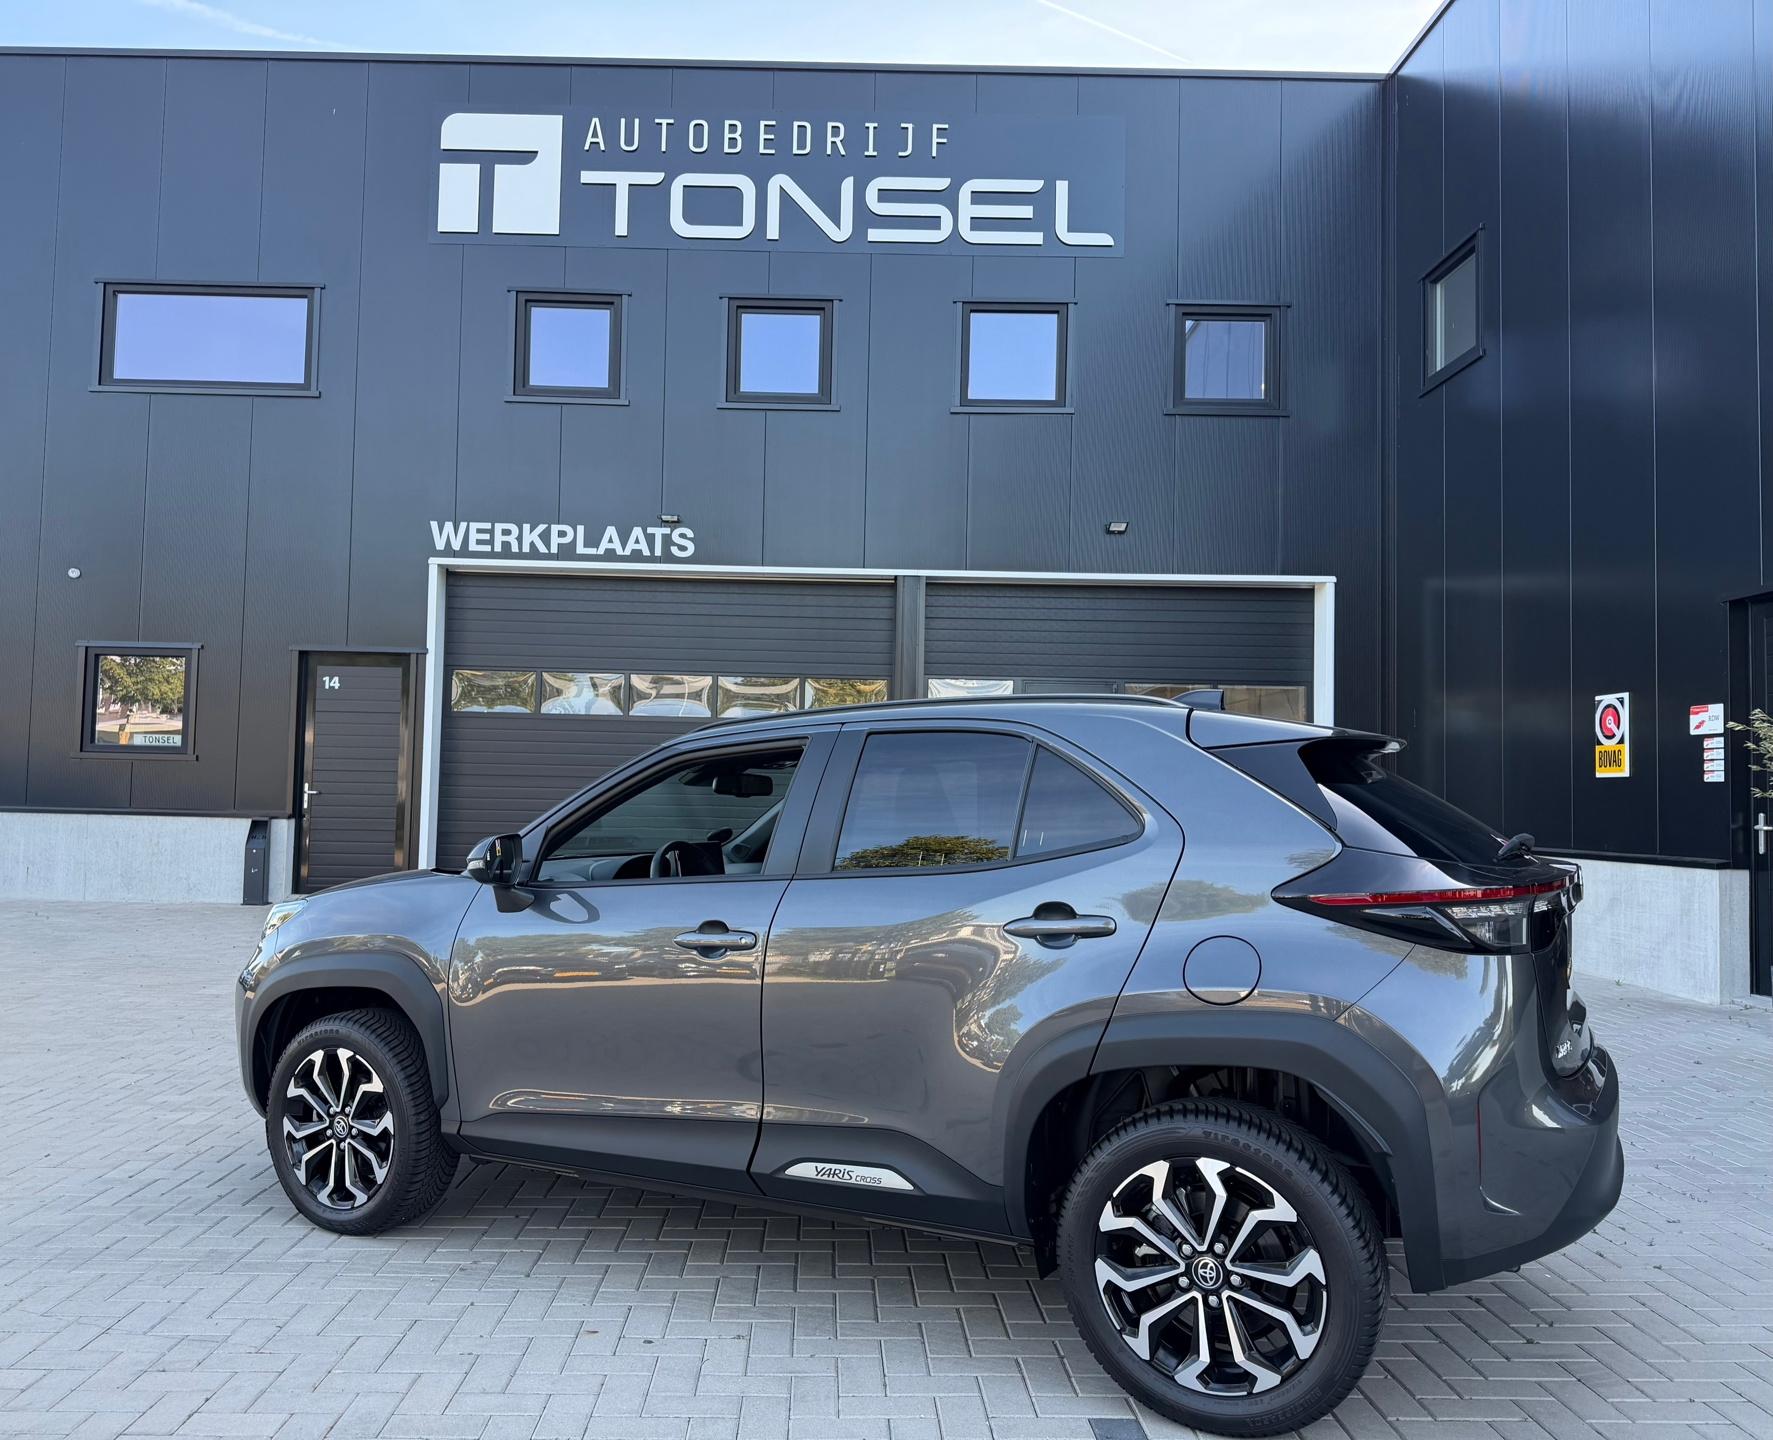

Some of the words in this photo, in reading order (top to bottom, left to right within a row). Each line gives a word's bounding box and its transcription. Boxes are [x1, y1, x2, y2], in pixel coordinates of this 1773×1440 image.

[583, 117, 950, 157] AUTOBEDRIJF
[580, 170, 1115, 247] TONSEL
[429, 520, 695, 558] WERKPLAATS
[322, 676, 341, 690] 14
[142, 735, 177, 745] TONSEL
[1598, 749, 1622, 768] BOVAG
[854, 1175, 882, 1185] CROSS
